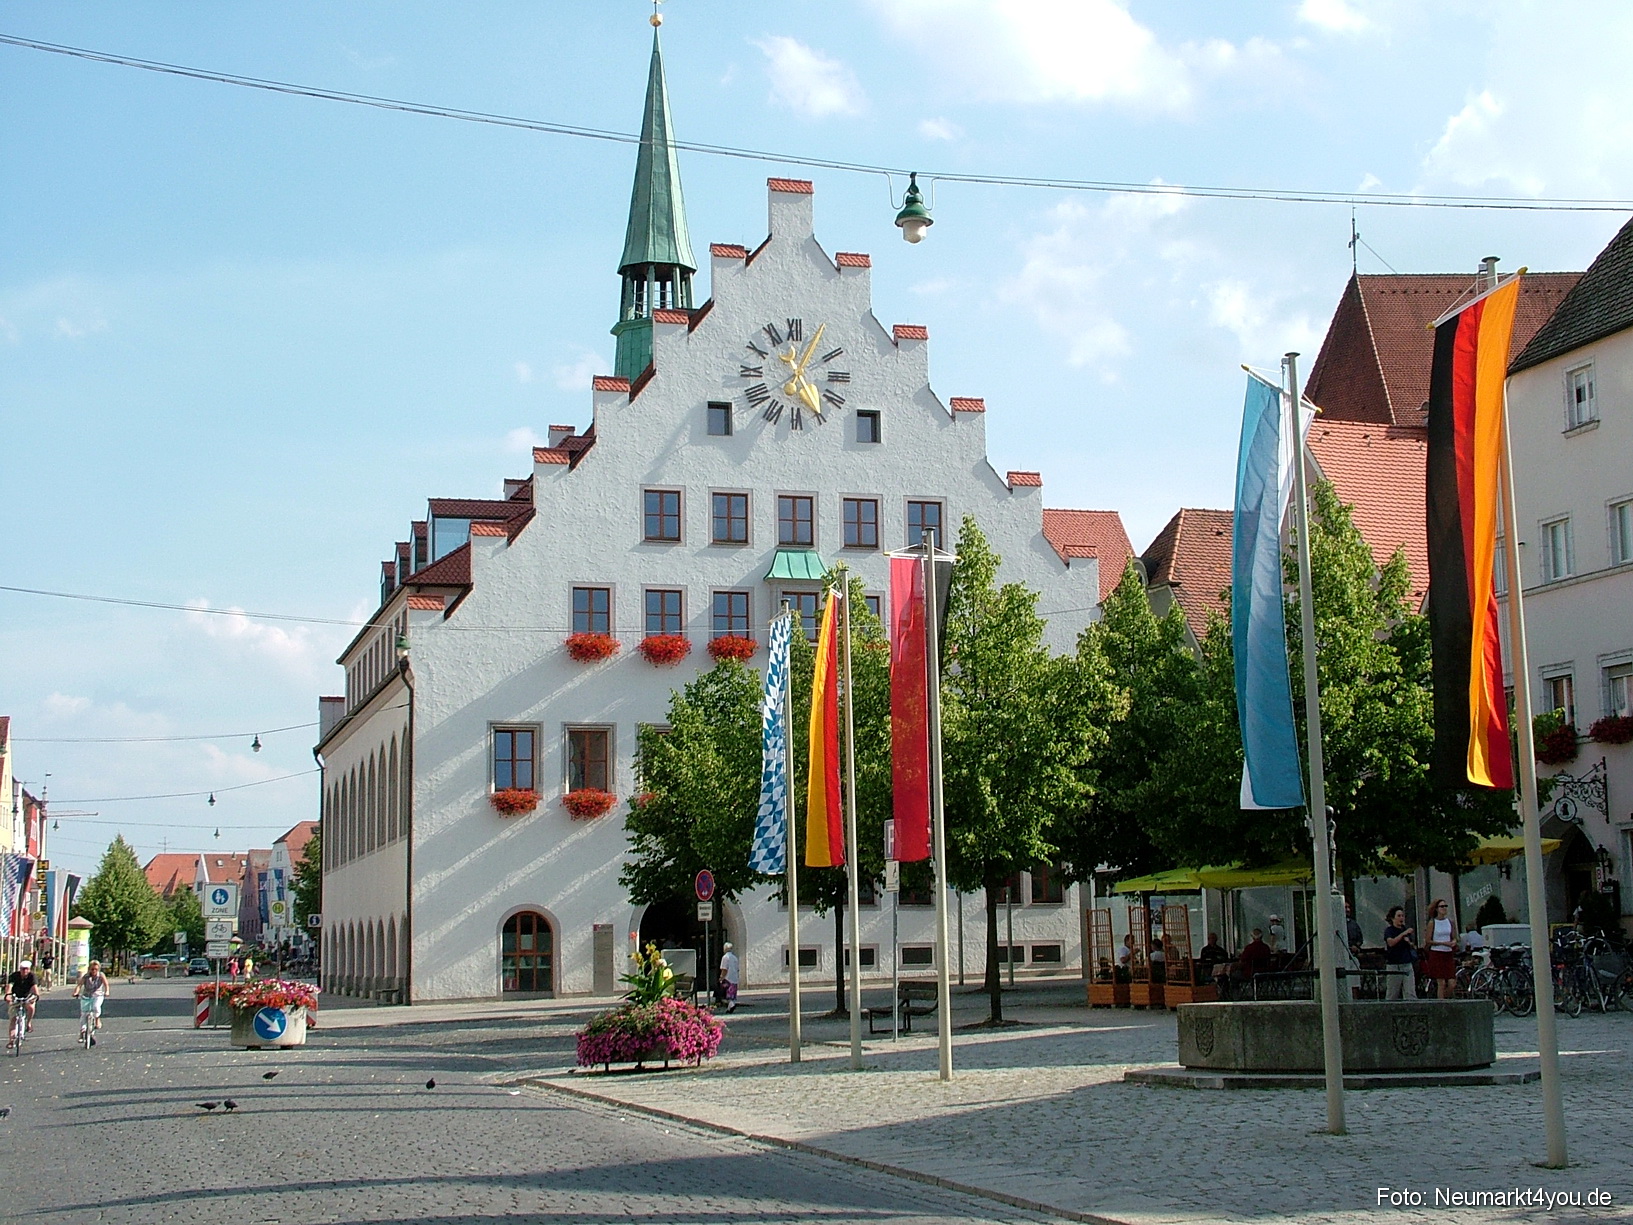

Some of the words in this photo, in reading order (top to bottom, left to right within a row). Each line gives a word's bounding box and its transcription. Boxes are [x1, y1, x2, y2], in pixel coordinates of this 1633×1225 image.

[762, 323, 783, 347] XI
[787, 318, 802, 341] XII
[746, 341, 769, 360] X
[822, 347, 843, 362] II
[740, 365, 763, 377] IX
[827, 371, 850, 382] III
[744, 383, 771, 408] VIII
[823, 388, 846, 409] IV
[763, 399, 784, 425] VII
[791, 406, 803, 430] VI
